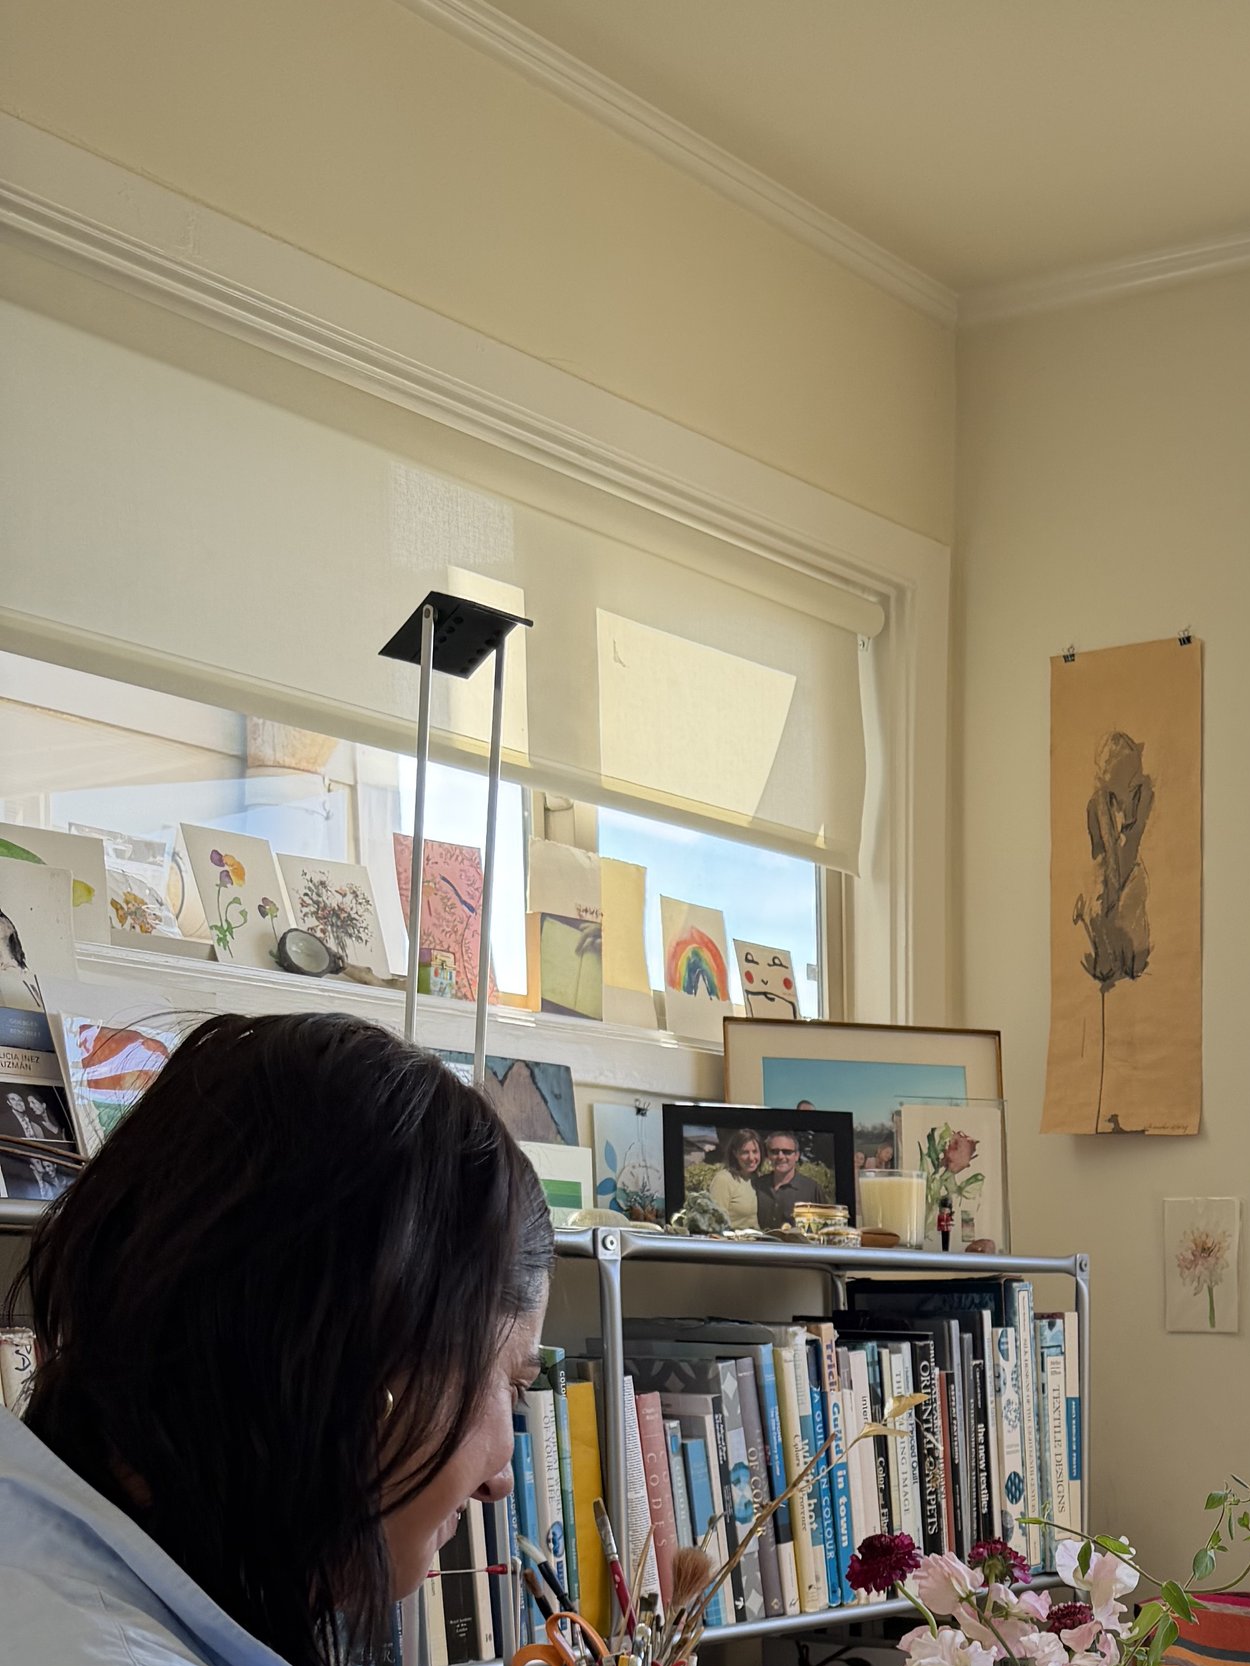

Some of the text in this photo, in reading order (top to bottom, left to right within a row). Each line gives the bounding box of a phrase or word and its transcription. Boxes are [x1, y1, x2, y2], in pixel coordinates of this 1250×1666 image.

[21, 1054, 40, 1064] INEZ
[1052, 1384, 1064, 1450] TEXTILE
[544, 1436, 554, 1472] YOUR
[747, 1446, 760, 1470] OF
[952, 1420, 960, 1465] PATTERNS
[820, 1464, 829, 1489] ON
[837, 1469, 847, 1489] in
[876, 1456, 886, 1490] Color
[911, 1460, 920, 1486] Quilt
[977, 1423, 989, 1515] the new textiles
[1054, 1451, 1066, 1515] DESIGNS
[546, 1477, 556, 1505] LIFE
[647, 1452, 669, 1548] CODES
[902, 1470, 911, 1514] IMAGE
[806, 1498, 818, 1531] hot
[822, 1496, 835, 1560] COLOUR
[839, 1495, 849, 1548] town
